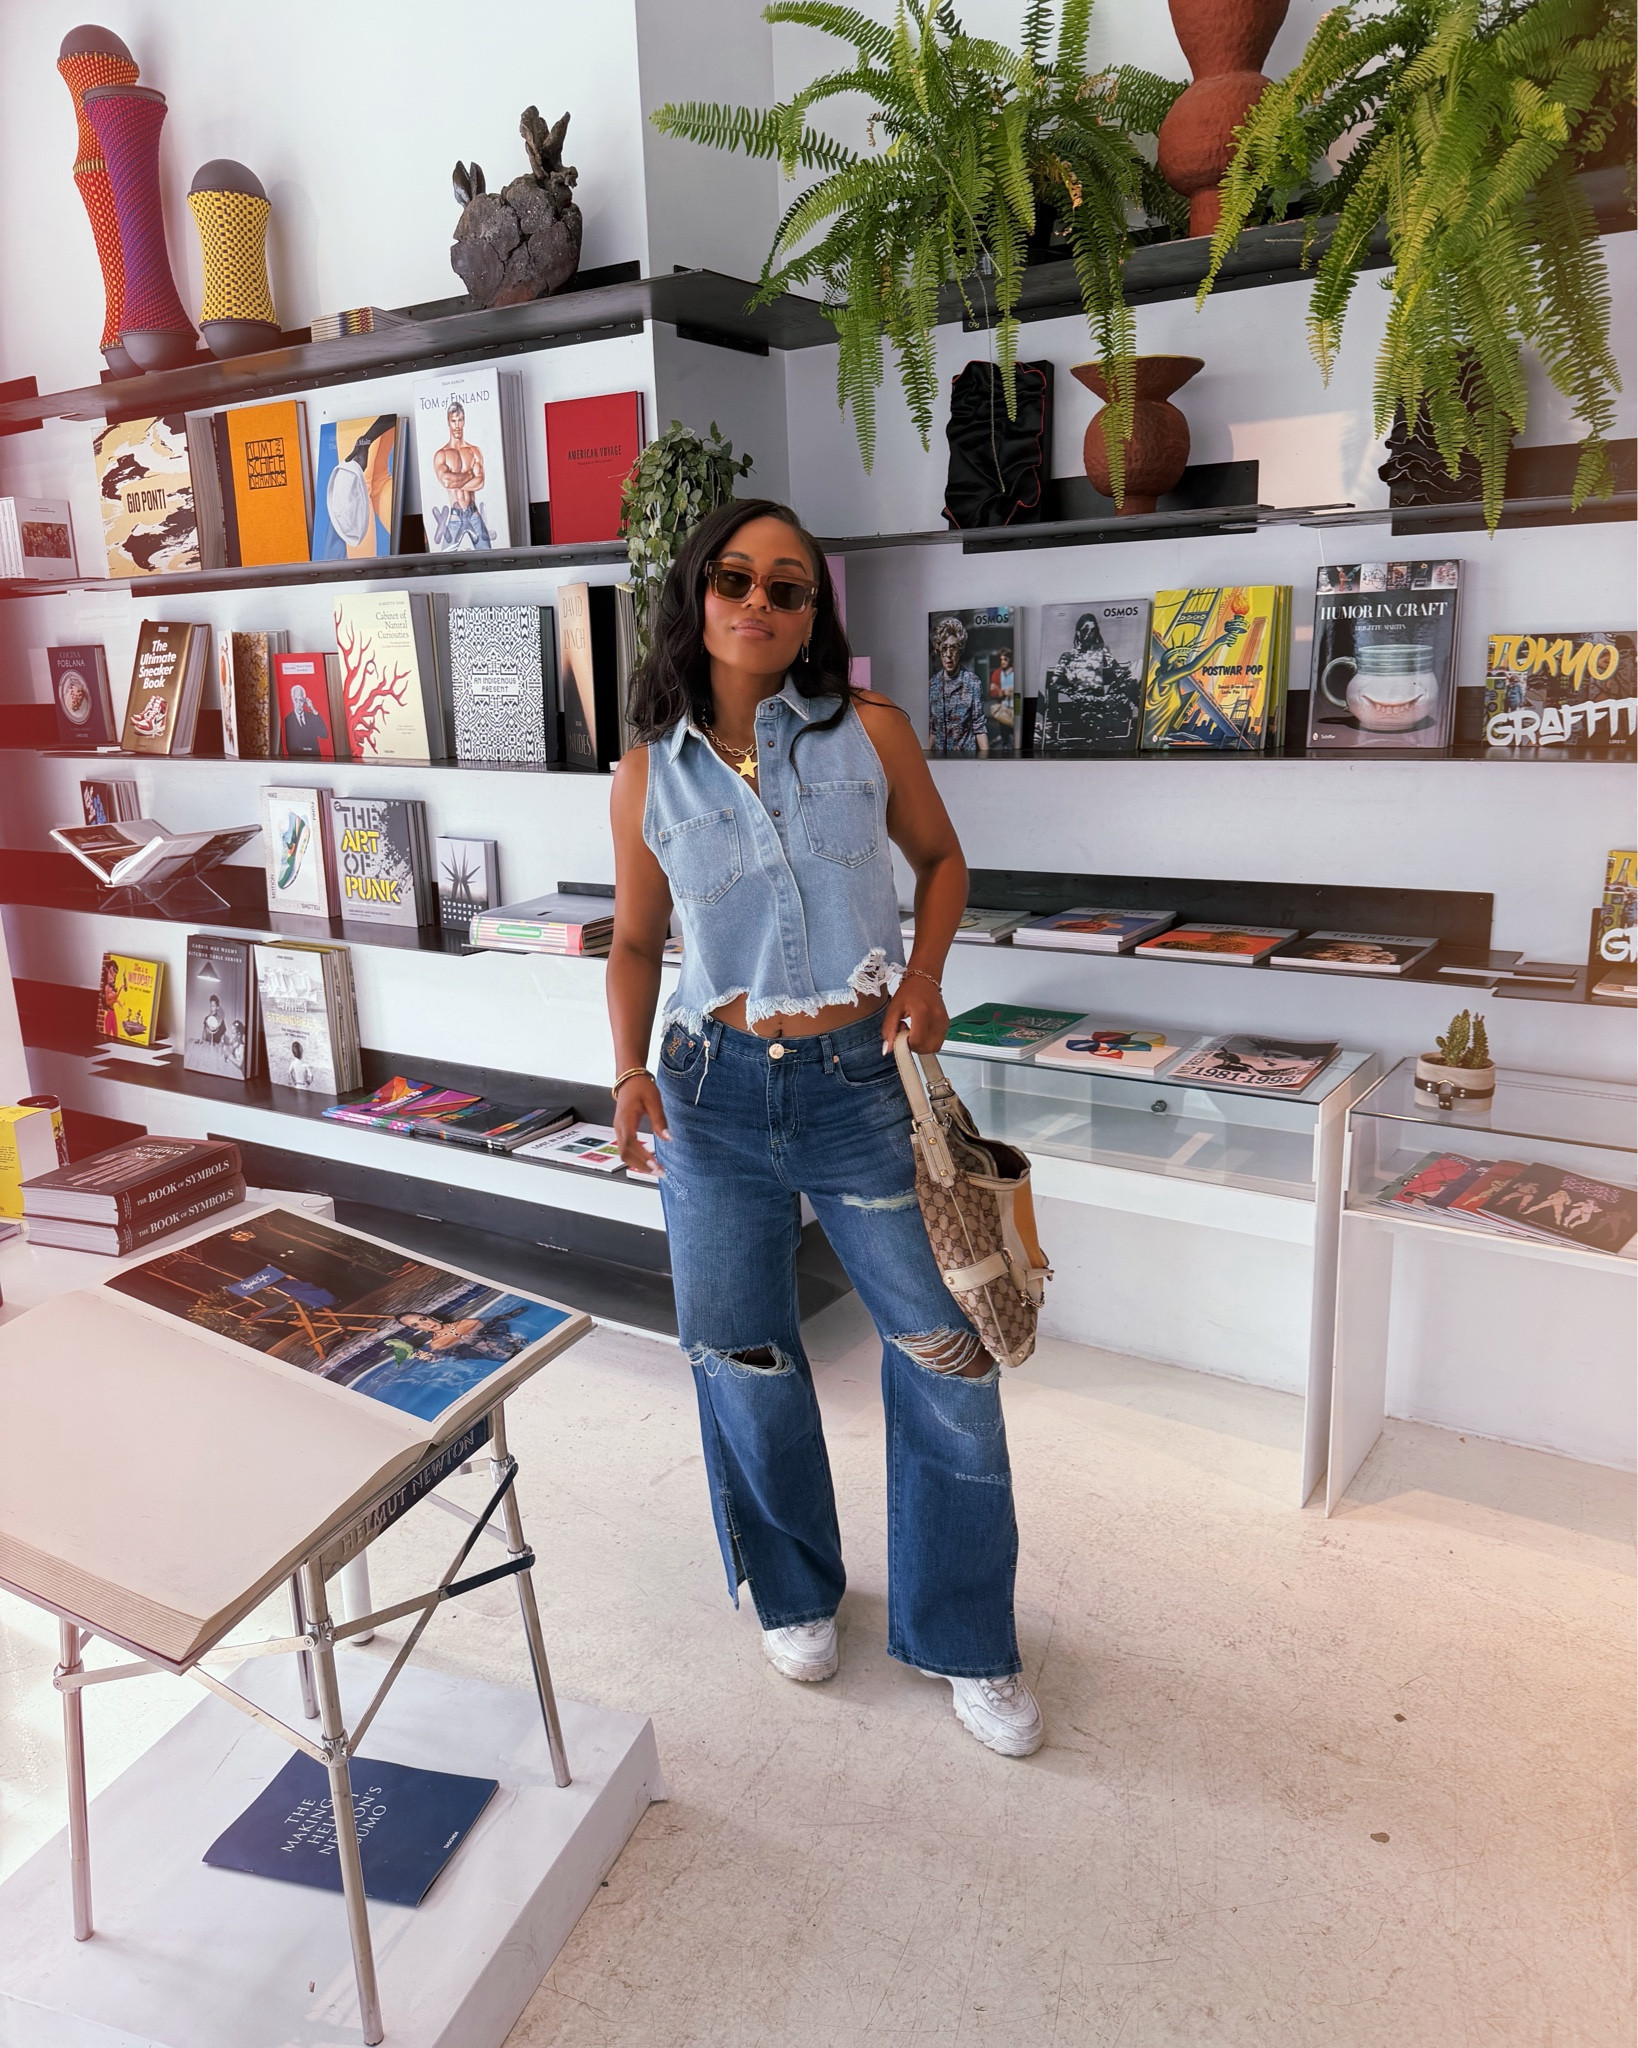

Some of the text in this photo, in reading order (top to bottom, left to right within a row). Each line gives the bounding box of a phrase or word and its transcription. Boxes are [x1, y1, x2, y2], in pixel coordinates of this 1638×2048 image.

[420, 390, 490, 410] TOM of FINLAND
[568, 445, 622, 460] AMERICAN VOYAGE
[127, 489, 166, 513] GIO PONTI
[563, 595, 582, 618] DAVID
[1103, 606, 1139, 617] OSMOS
[1320, 602, 1448, 620] HUMOR IN CRAFT
[376, 610, 407, 620] Cabinet of
[975, 614, 1009, 625] OSMOS
[385, 620, 408, 629] Natural
[378, 631, 409, 639] Curiosities
[564, 628, 586, 649] LYNCH
[152, 640, 168, 652] The
[140, 652, 177, 665] Ultimate
[1489, 635, 1619, 691] TOKYO
[138, 664, 174, 678] Sneaker
[1202, 665, 1263, 676] POSTWAR POP
[143, 676, 166, 689] Book
[483, 677, 516, 685] INDIGENOUS
[481, 685, 509, 693] PRESENT
[570, 733, 591, 756] NUDES
[339, 804, 379, 829] THE
[341, 829, 380, 854] ART
[343, 853, 372, 876] OF
[345, 876, 401, 904] PUNK
[442, 900, 483, 910] SPOMENIK
[442, 907, 478, 917] MONUMEN
[442, 914, 472, 922] DATABA
[1200, 924, 1275, 934] TOOTHACHE
[1333, 933, 1415, 943] TOOTHACHE
[137, 1198, 147, 1206] THE
[148, 1182, 178, 1203] BOOK
[185, 1160, 230, 1186] SYMBOLS
[138, 1229, 149, 1237] THE
[150, 1213, 180, 1233] BOOK
[188, 1189, 234, 1216] SYMBOLS
[341, 1430, 475, 1556] HELMUT NEWTON
[284, 1798, 316, 1824] THE
[281, 1798, 334, 1852] MAKING
[443, 1831, 459, 1849] TASCHEN
